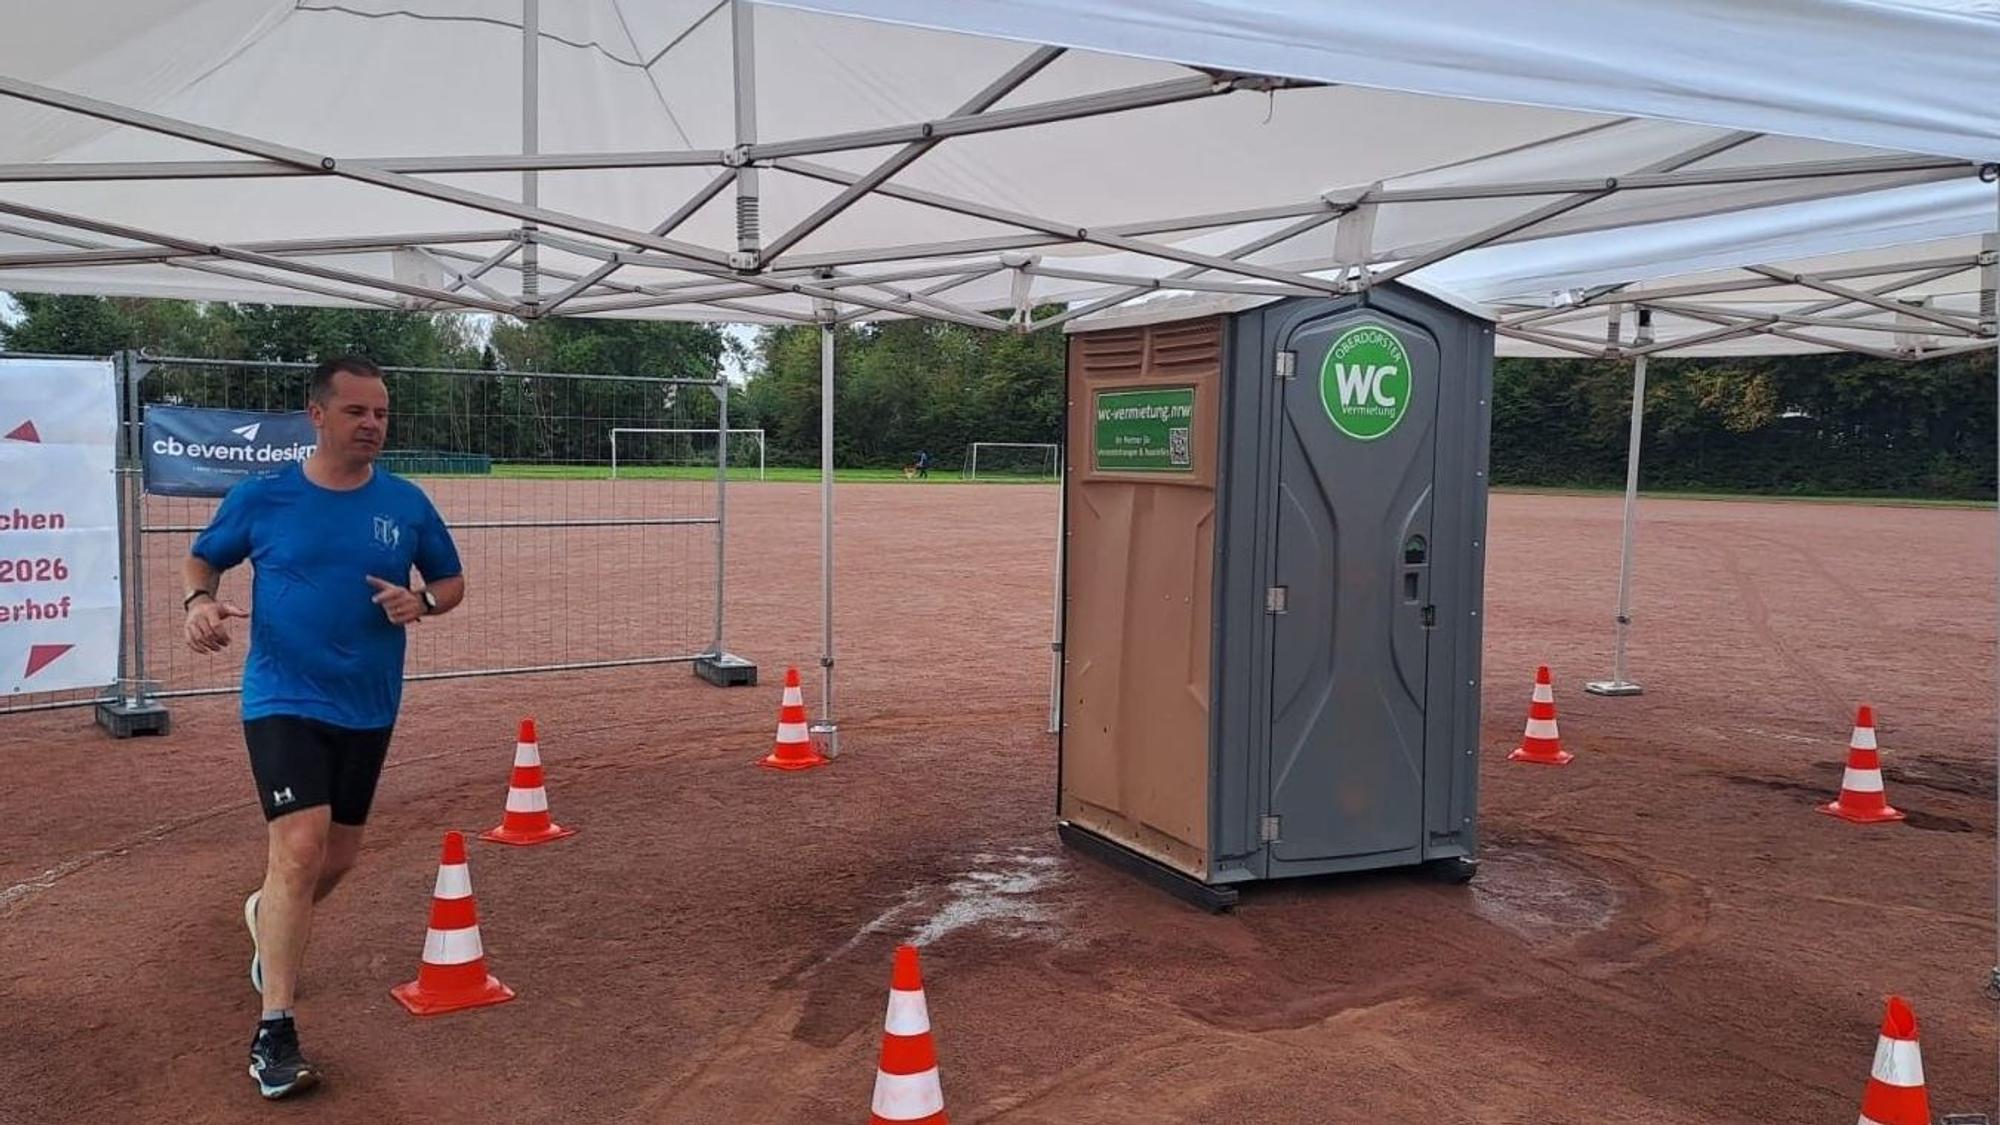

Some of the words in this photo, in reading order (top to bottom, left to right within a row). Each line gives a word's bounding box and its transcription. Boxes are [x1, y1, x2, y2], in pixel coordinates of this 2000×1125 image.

[1335, 363, 1397, 407] WC
[1098, 404, 1192, 422] wc-vermietung.nrw
[153, 437, 184, 456] cb
[187, 445, 254, 462] event
[0, 508, 64, 530] chen
[0, 558, 68, 582] 2026
[0, 596, 70, 622] erhof
